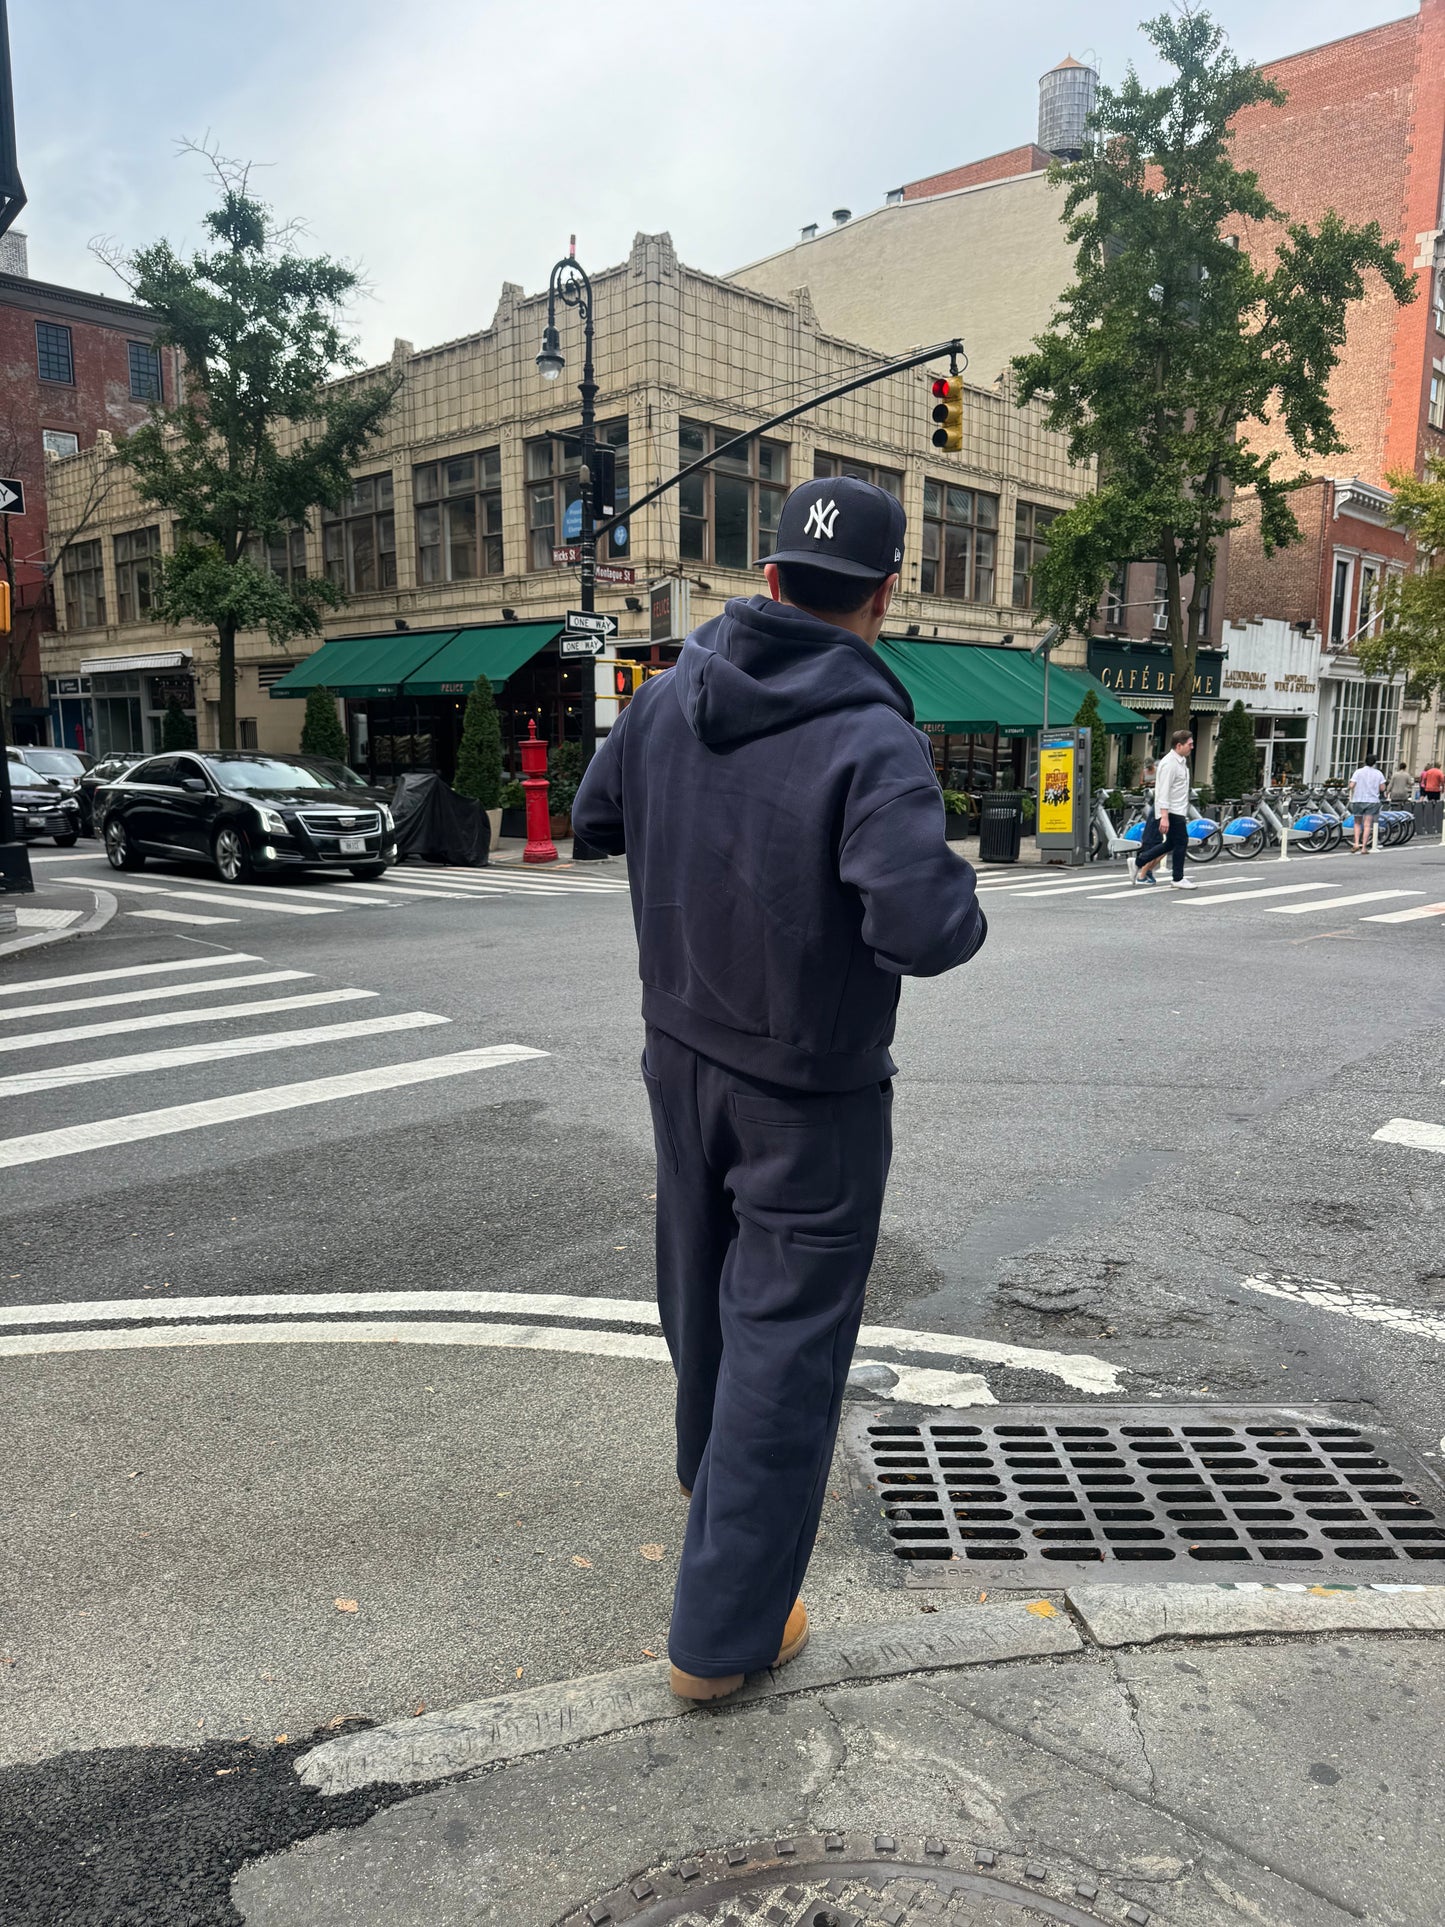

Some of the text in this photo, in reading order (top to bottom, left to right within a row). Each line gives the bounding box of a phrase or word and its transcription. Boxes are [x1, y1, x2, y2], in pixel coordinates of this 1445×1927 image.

[803, 498, 840, 539] NY
[553, 549, 576, 562] Hicks St
[595, 567, 631, 582] Montague St
[653, 597, 670, 618] FELICE
[574, 617, 612, 630] ONE WAY
[566, 641, 599, 651] ONE WAY
[1101, 665, 1150, 690] CAFÉ
[440, 683, 464, 693] FELICE
[923, 723, 945, 733] FELICE
